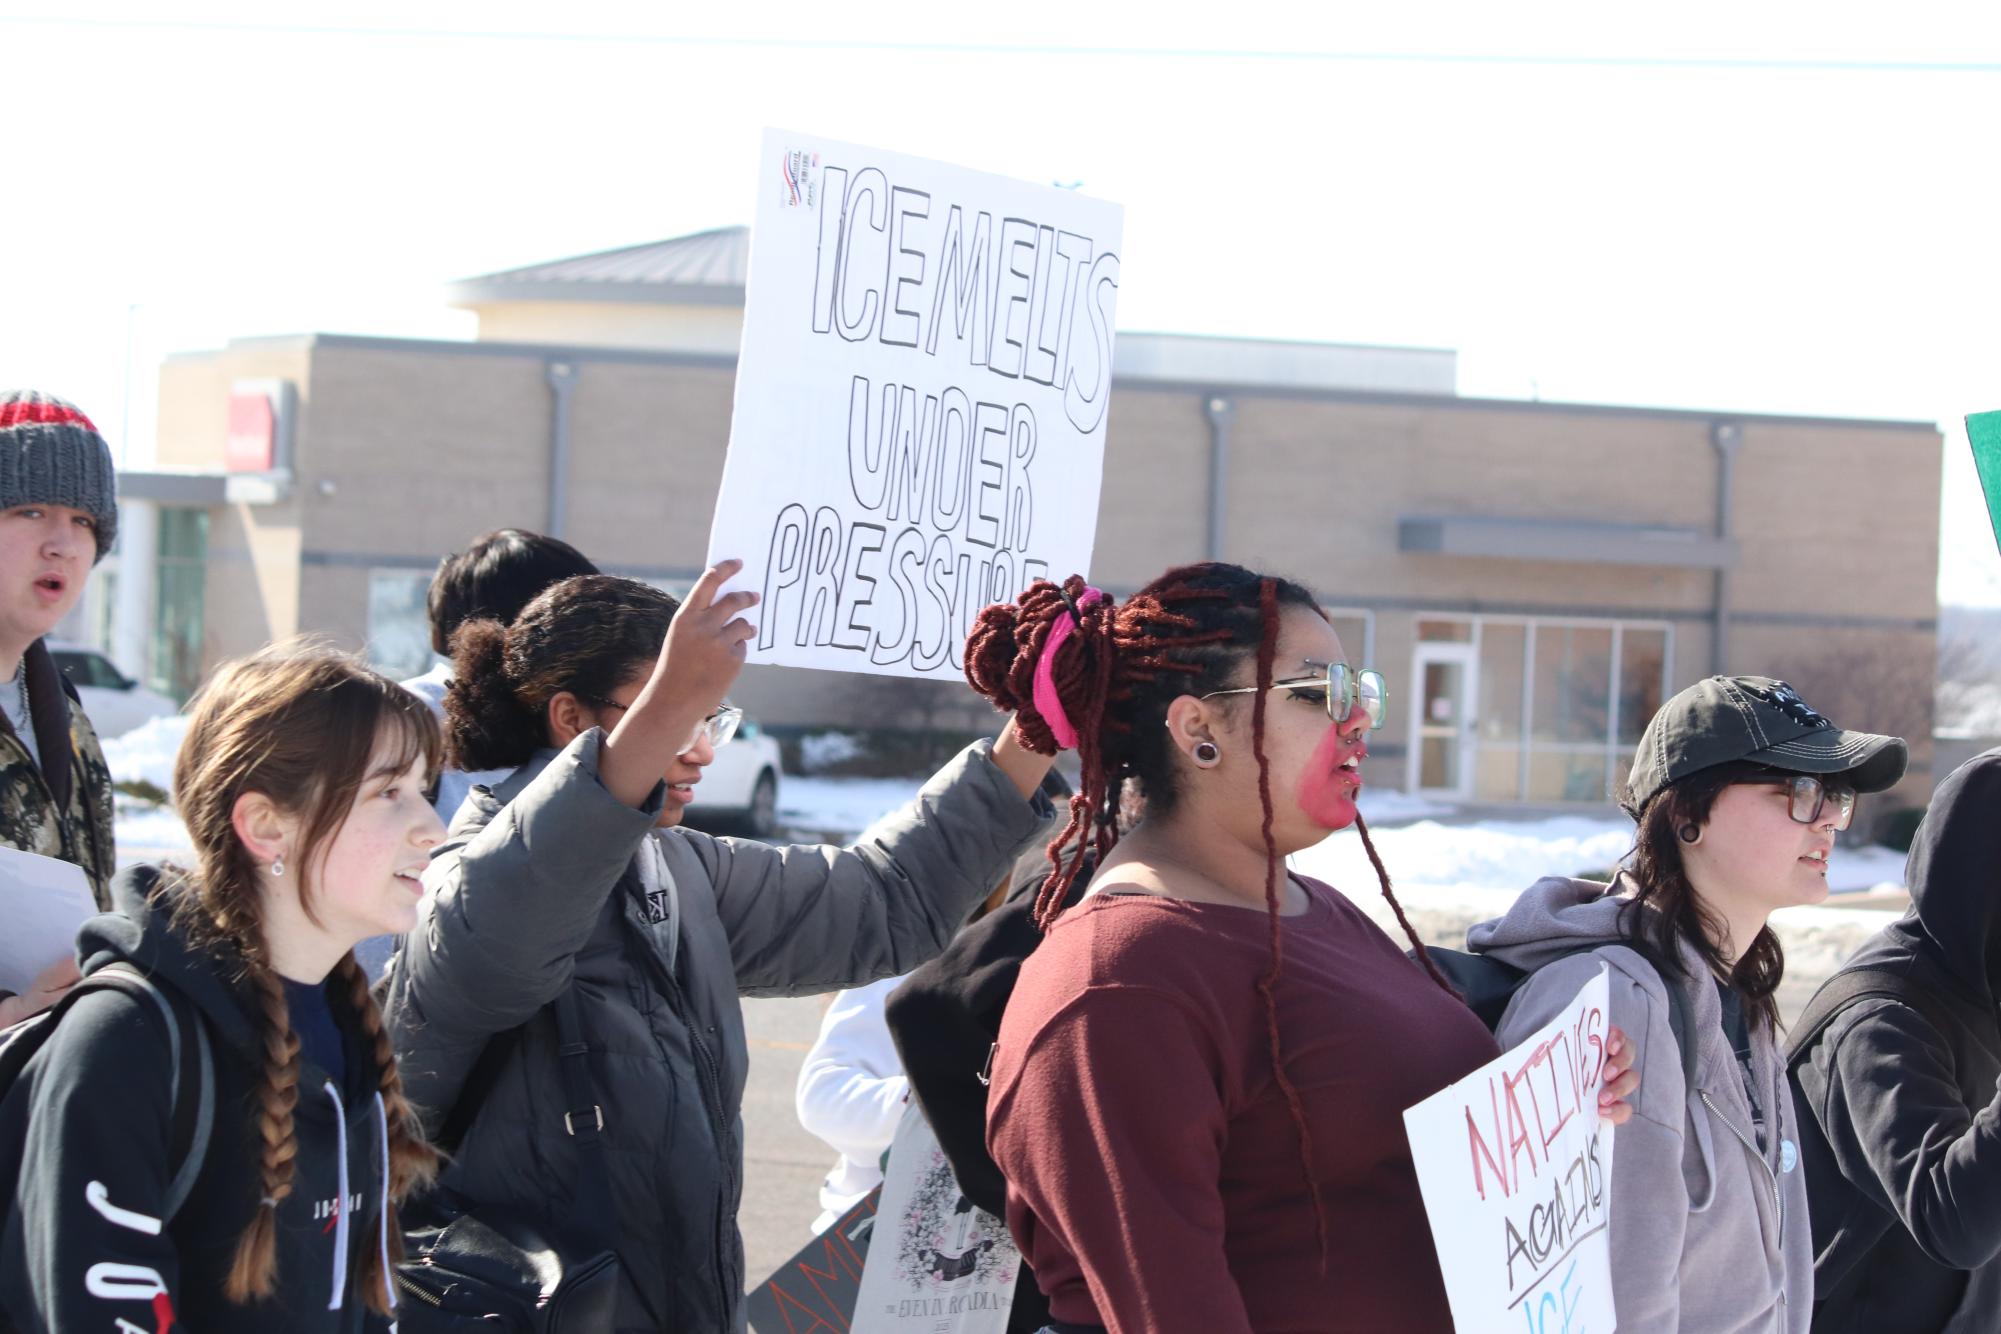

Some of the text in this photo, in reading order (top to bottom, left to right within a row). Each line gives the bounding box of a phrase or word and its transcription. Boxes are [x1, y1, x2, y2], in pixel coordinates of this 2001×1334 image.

[812, 166, 1121, 434] ICE MELTS
[848, 376, 1037, 552] UNDER
[1465, 1008, 1603, 1201] NATIVES
[1504, 1132, 1602, 1291] AGAINS
